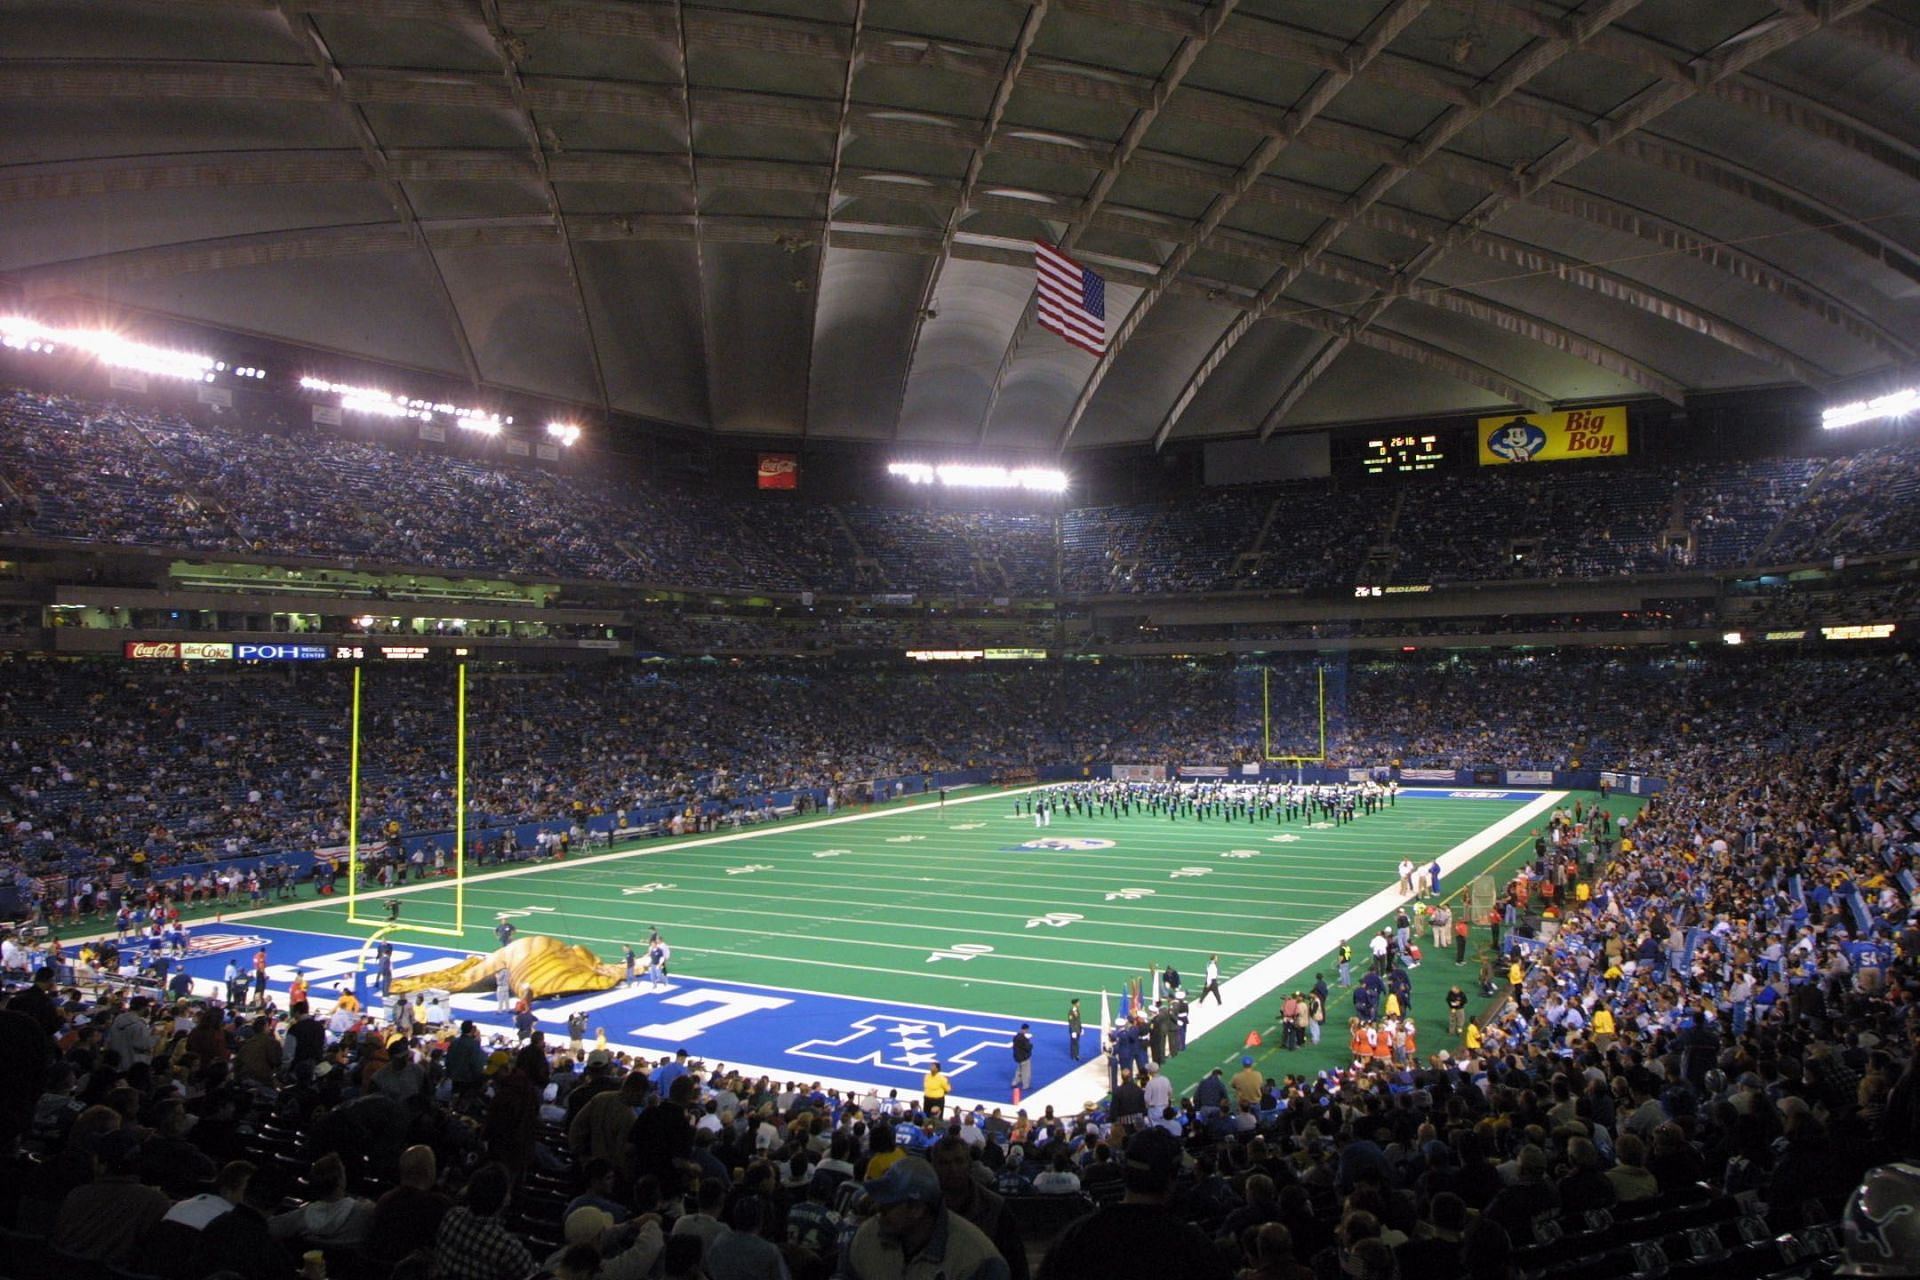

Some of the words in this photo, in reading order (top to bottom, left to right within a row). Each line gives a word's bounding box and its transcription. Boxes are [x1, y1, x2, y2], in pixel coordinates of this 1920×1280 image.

[1564, 411, 1606, 433] Big
[1567, 431, 1615, 454] Boy
[132, 643, 176, 658] Coca-Cola
[184, 645, 200, 655] diet
[201, 645, 230, 658] Coke
[239, 645, 299, 658] POH
[622, 882, 677, 896] 20
[1105, 888, 1155, 900] 30
[1025, 912, 1084, 928] 20
[926, 944, 994, 962] 10
[1860, 952, 1878, 965] 54
